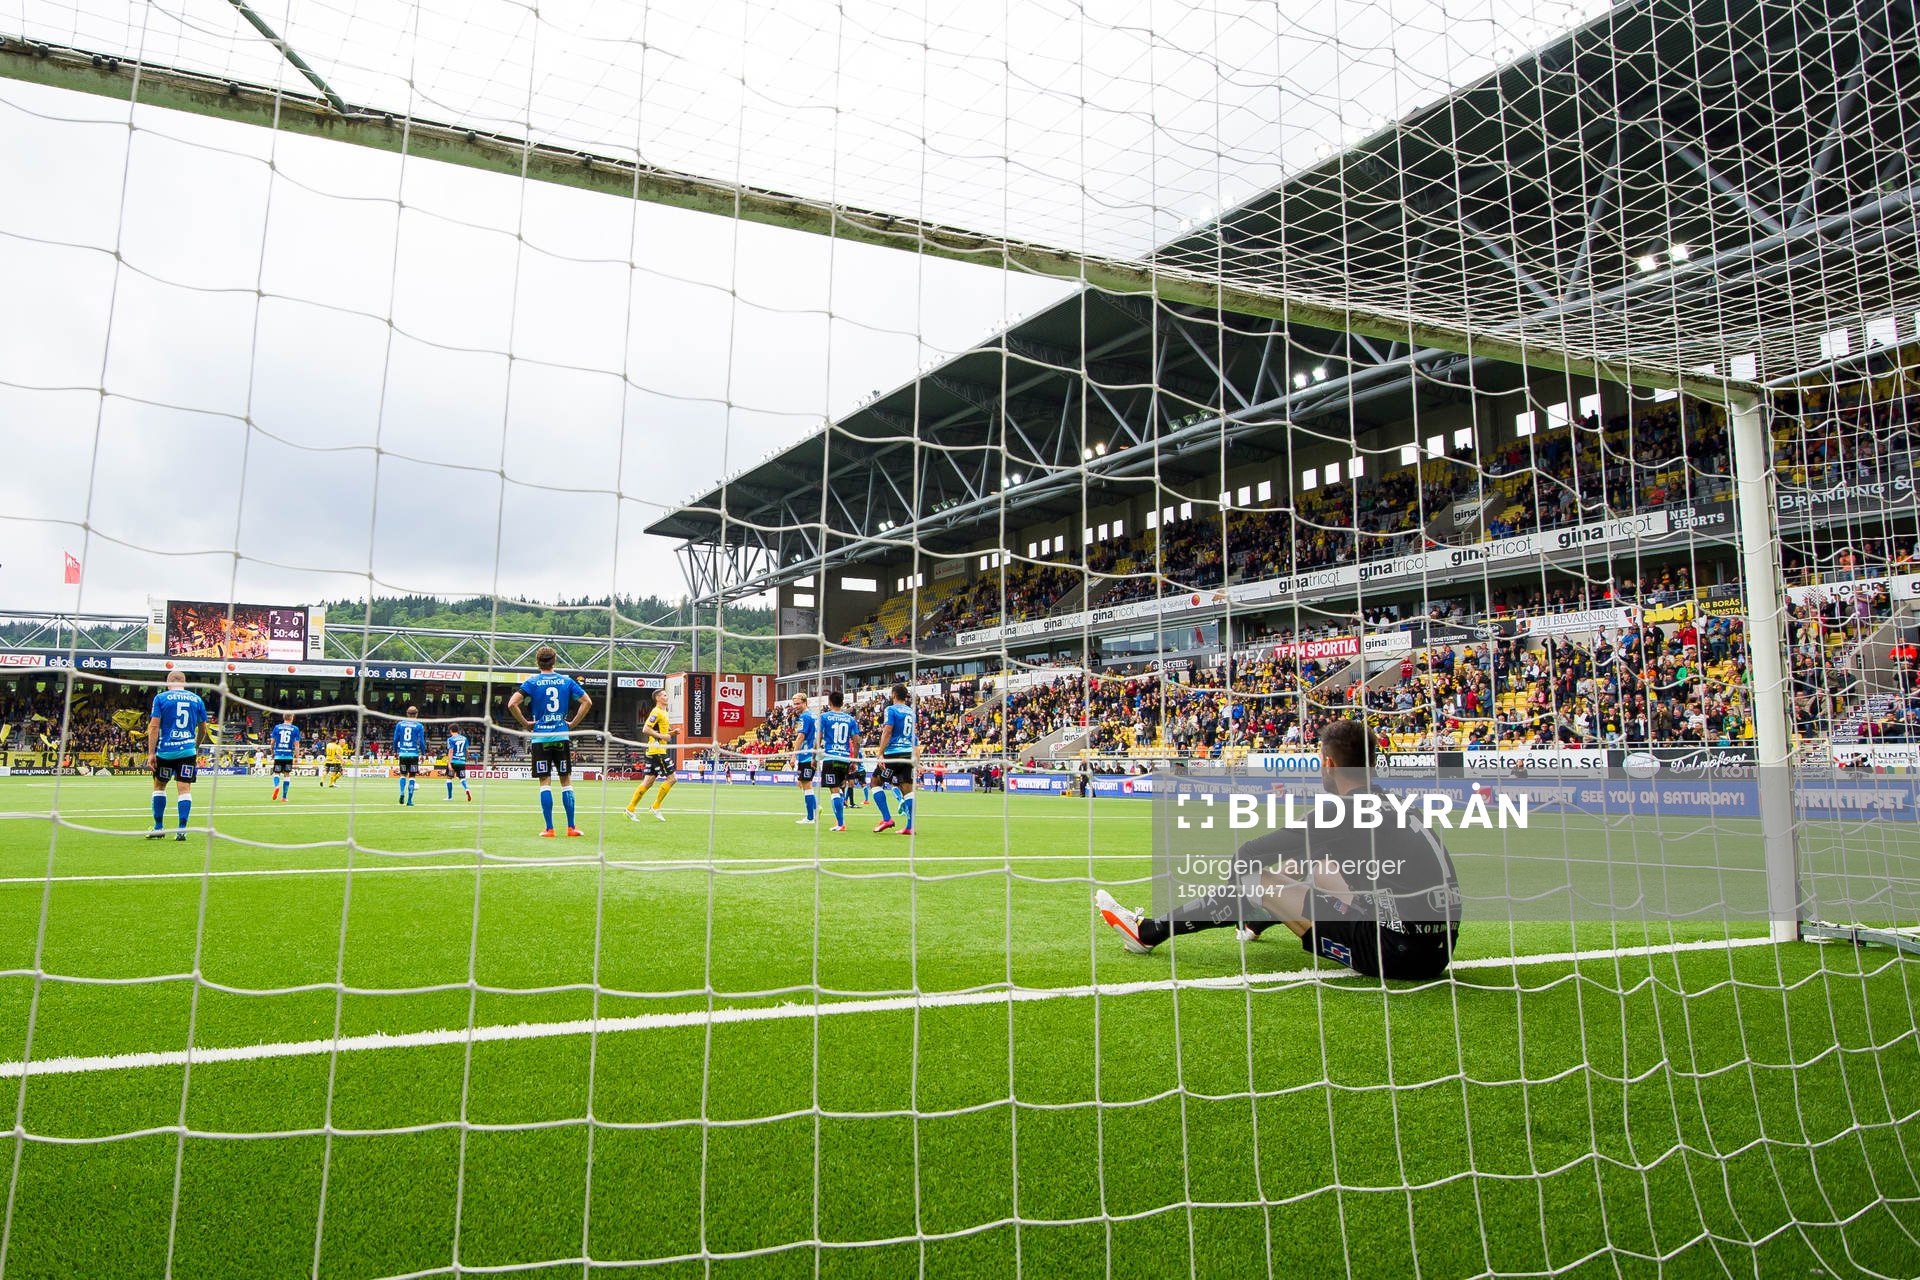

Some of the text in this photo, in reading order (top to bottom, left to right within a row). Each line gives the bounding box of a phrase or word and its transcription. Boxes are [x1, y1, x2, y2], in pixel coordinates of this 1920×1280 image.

[1894, 474, 1912, 490] &
[1674, 512, 1725, 529] SPORTS
[274, 616, 281, 625] 2
[292, 616, 299, 626] 0
[273, 628, 299, 638] 50:46
[82, 657, 107, 668] ellos
[386, 668, 408, 679] ellos
[413, 669, 462, 680] PULSEN
[546, 687, 559, 712] 3
[176, 702, 190, 728] 5
[722, 711, 740, 720] 7-23
[831, 722, 849, 743] 10
[903, 715, 913, 737] 6
[279, 731, 291, 743] 16
[403, 727, 412, 741] 8
[455, 740, 466, 754] 17
[1580, 791, 1604, 803] SEE
[1609, 791, 1636, 804] YOU
[1640, 791, 1659, 804] ON
[1663, 791, 1745, 806] SATURDAY!
